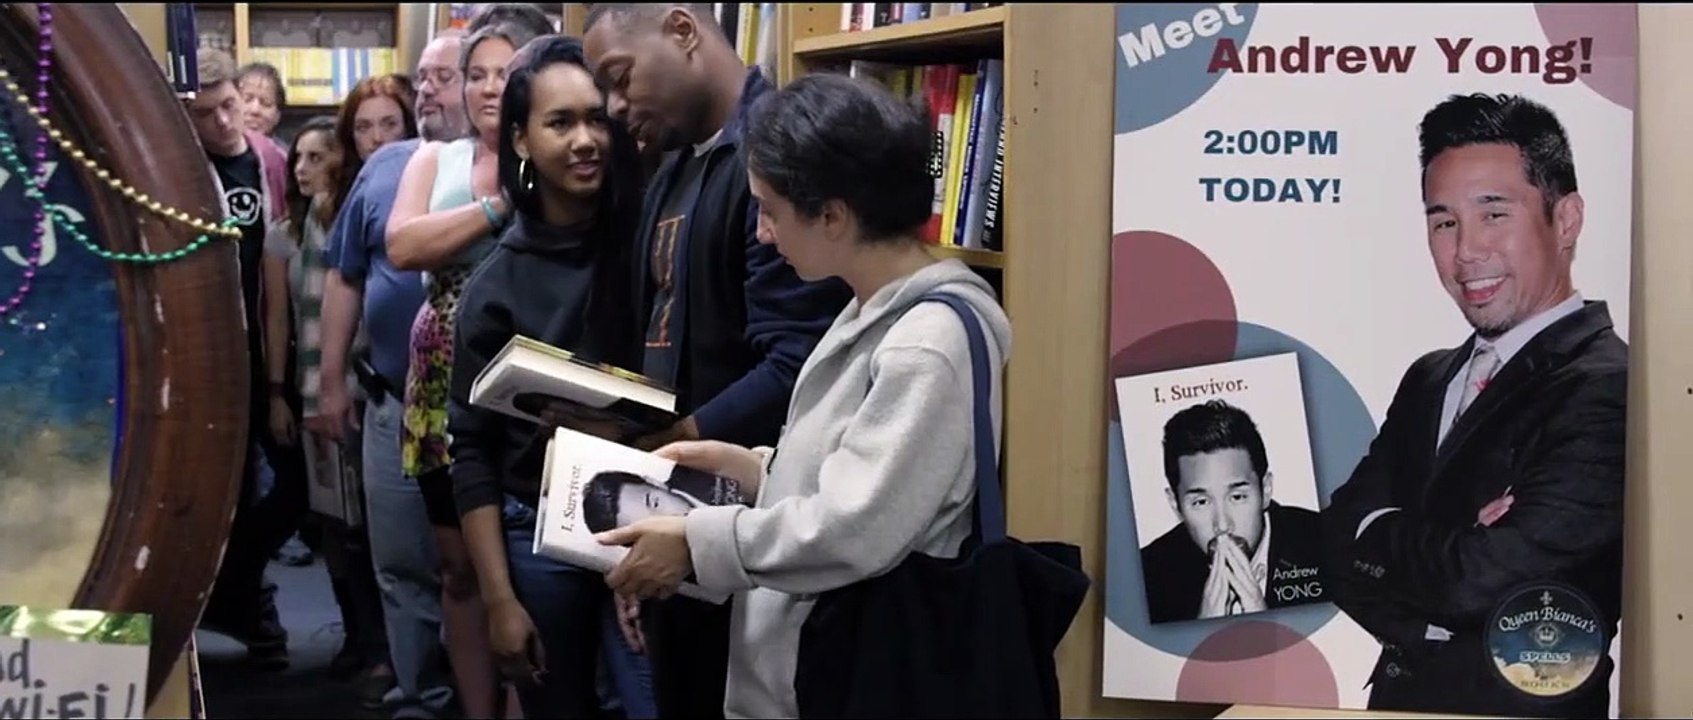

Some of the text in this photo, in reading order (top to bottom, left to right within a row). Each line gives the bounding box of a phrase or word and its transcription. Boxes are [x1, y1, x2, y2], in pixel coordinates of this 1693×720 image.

[1117, 4, 1246, 68] Meet
[1207, 36, 1594, 84] Andrew Yong!
[1203, 130, 1338, 155] 2:00PM
[984, 159, 1004, 228] INTERVIEWS
[1198, 178, 1341, 203] TODAY!
[1170, 378, 1248, 402] Survivor.
[1272, 564, 1319, 580] Andrew
[1273, 581, 1323, 602] YONG
[1498, 606, 1597, 633] Queen Bianca's
